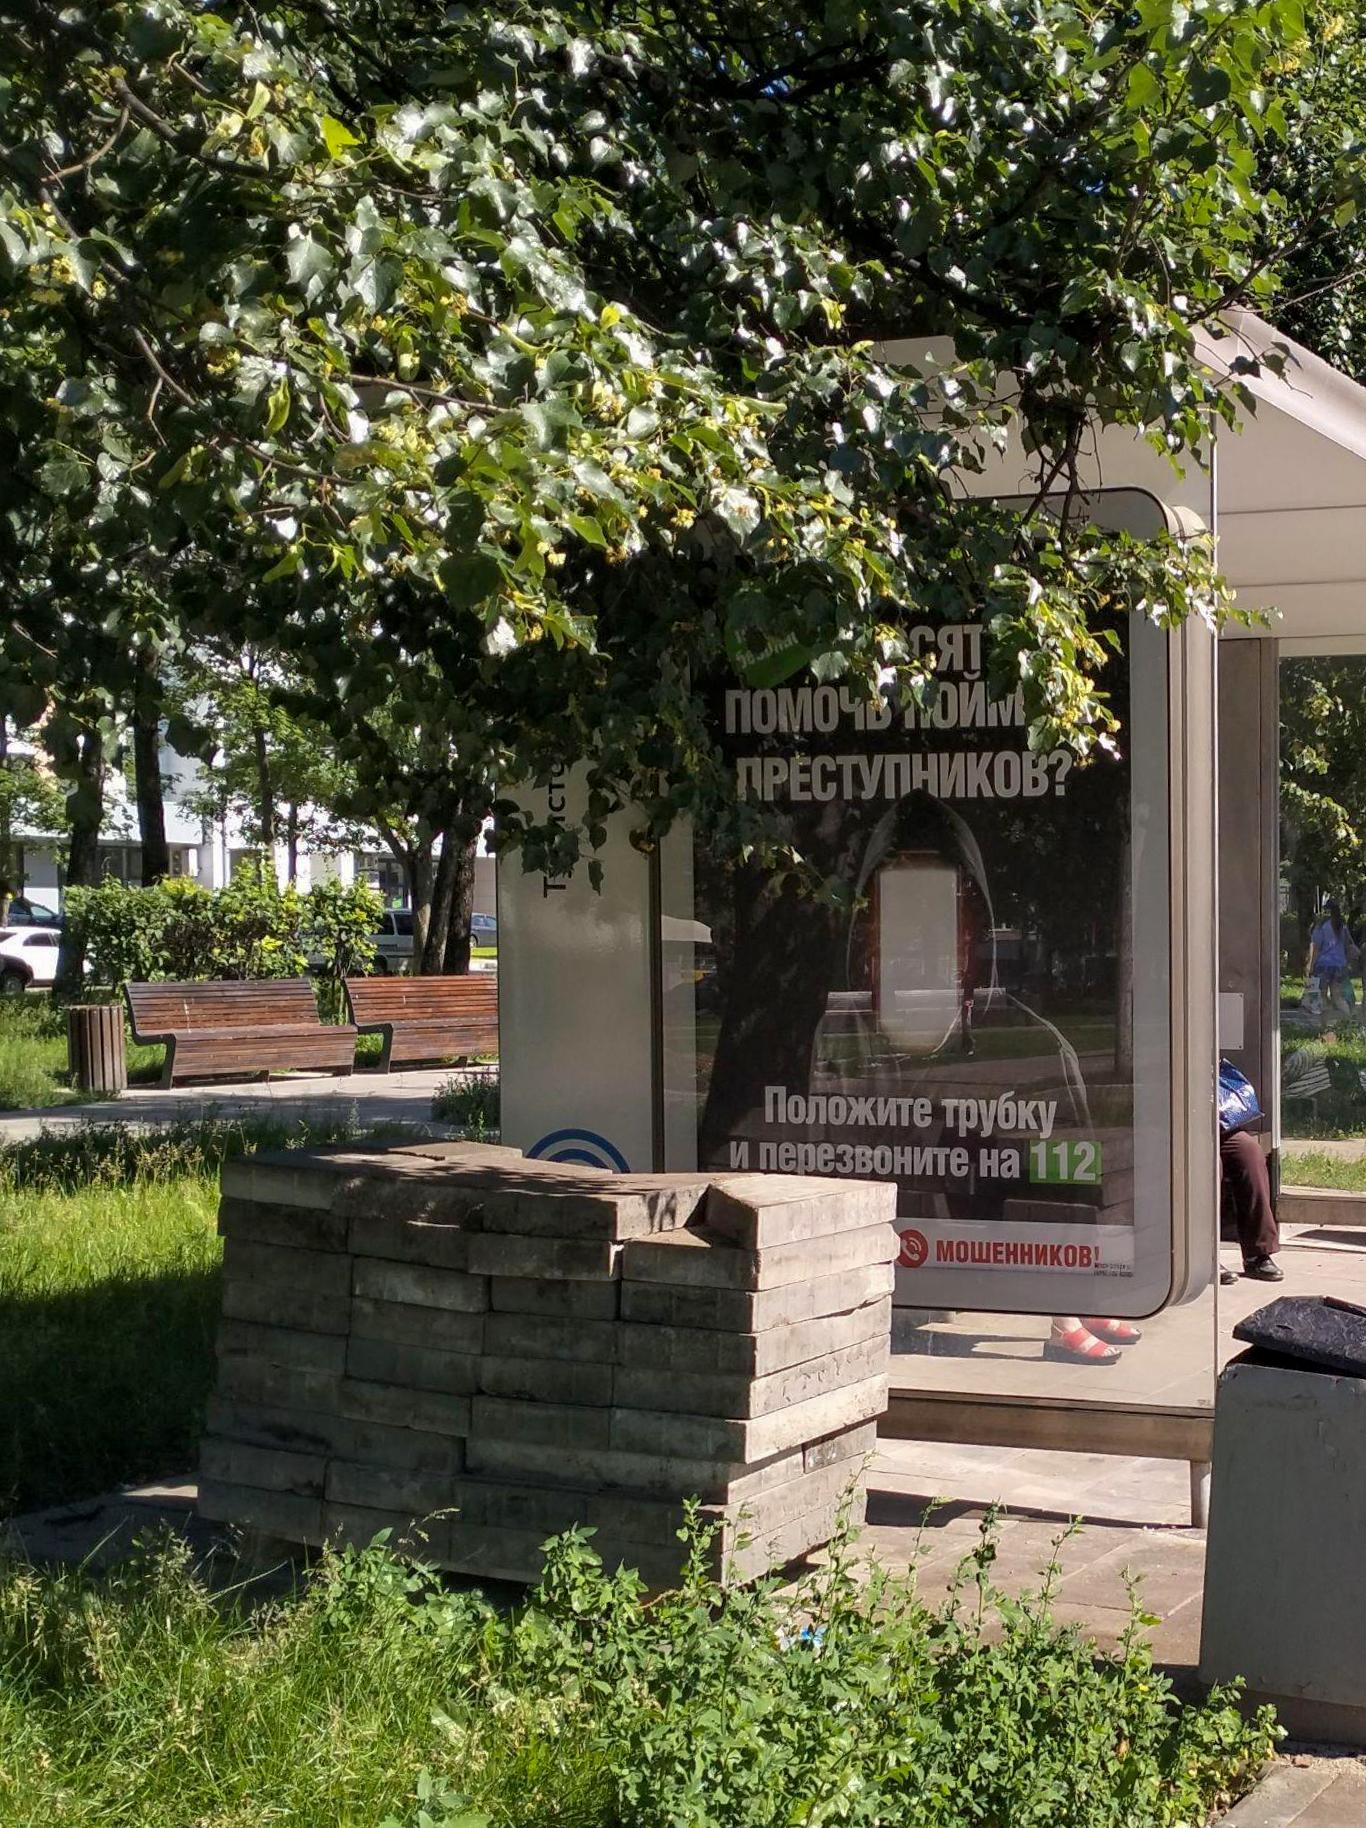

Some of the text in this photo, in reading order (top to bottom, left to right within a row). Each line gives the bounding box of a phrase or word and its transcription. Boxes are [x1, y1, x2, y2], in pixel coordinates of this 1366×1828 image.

[736, 748, 1073, 802] ПРЕСТУПНИКОВ?
[764, 1085, 1057, 1139] Положите трубку
[730, 1141, 1096, 1181] и перезвоните на 112
[936, 1240, 1100, 1268] МОШЕННИКОВ!
